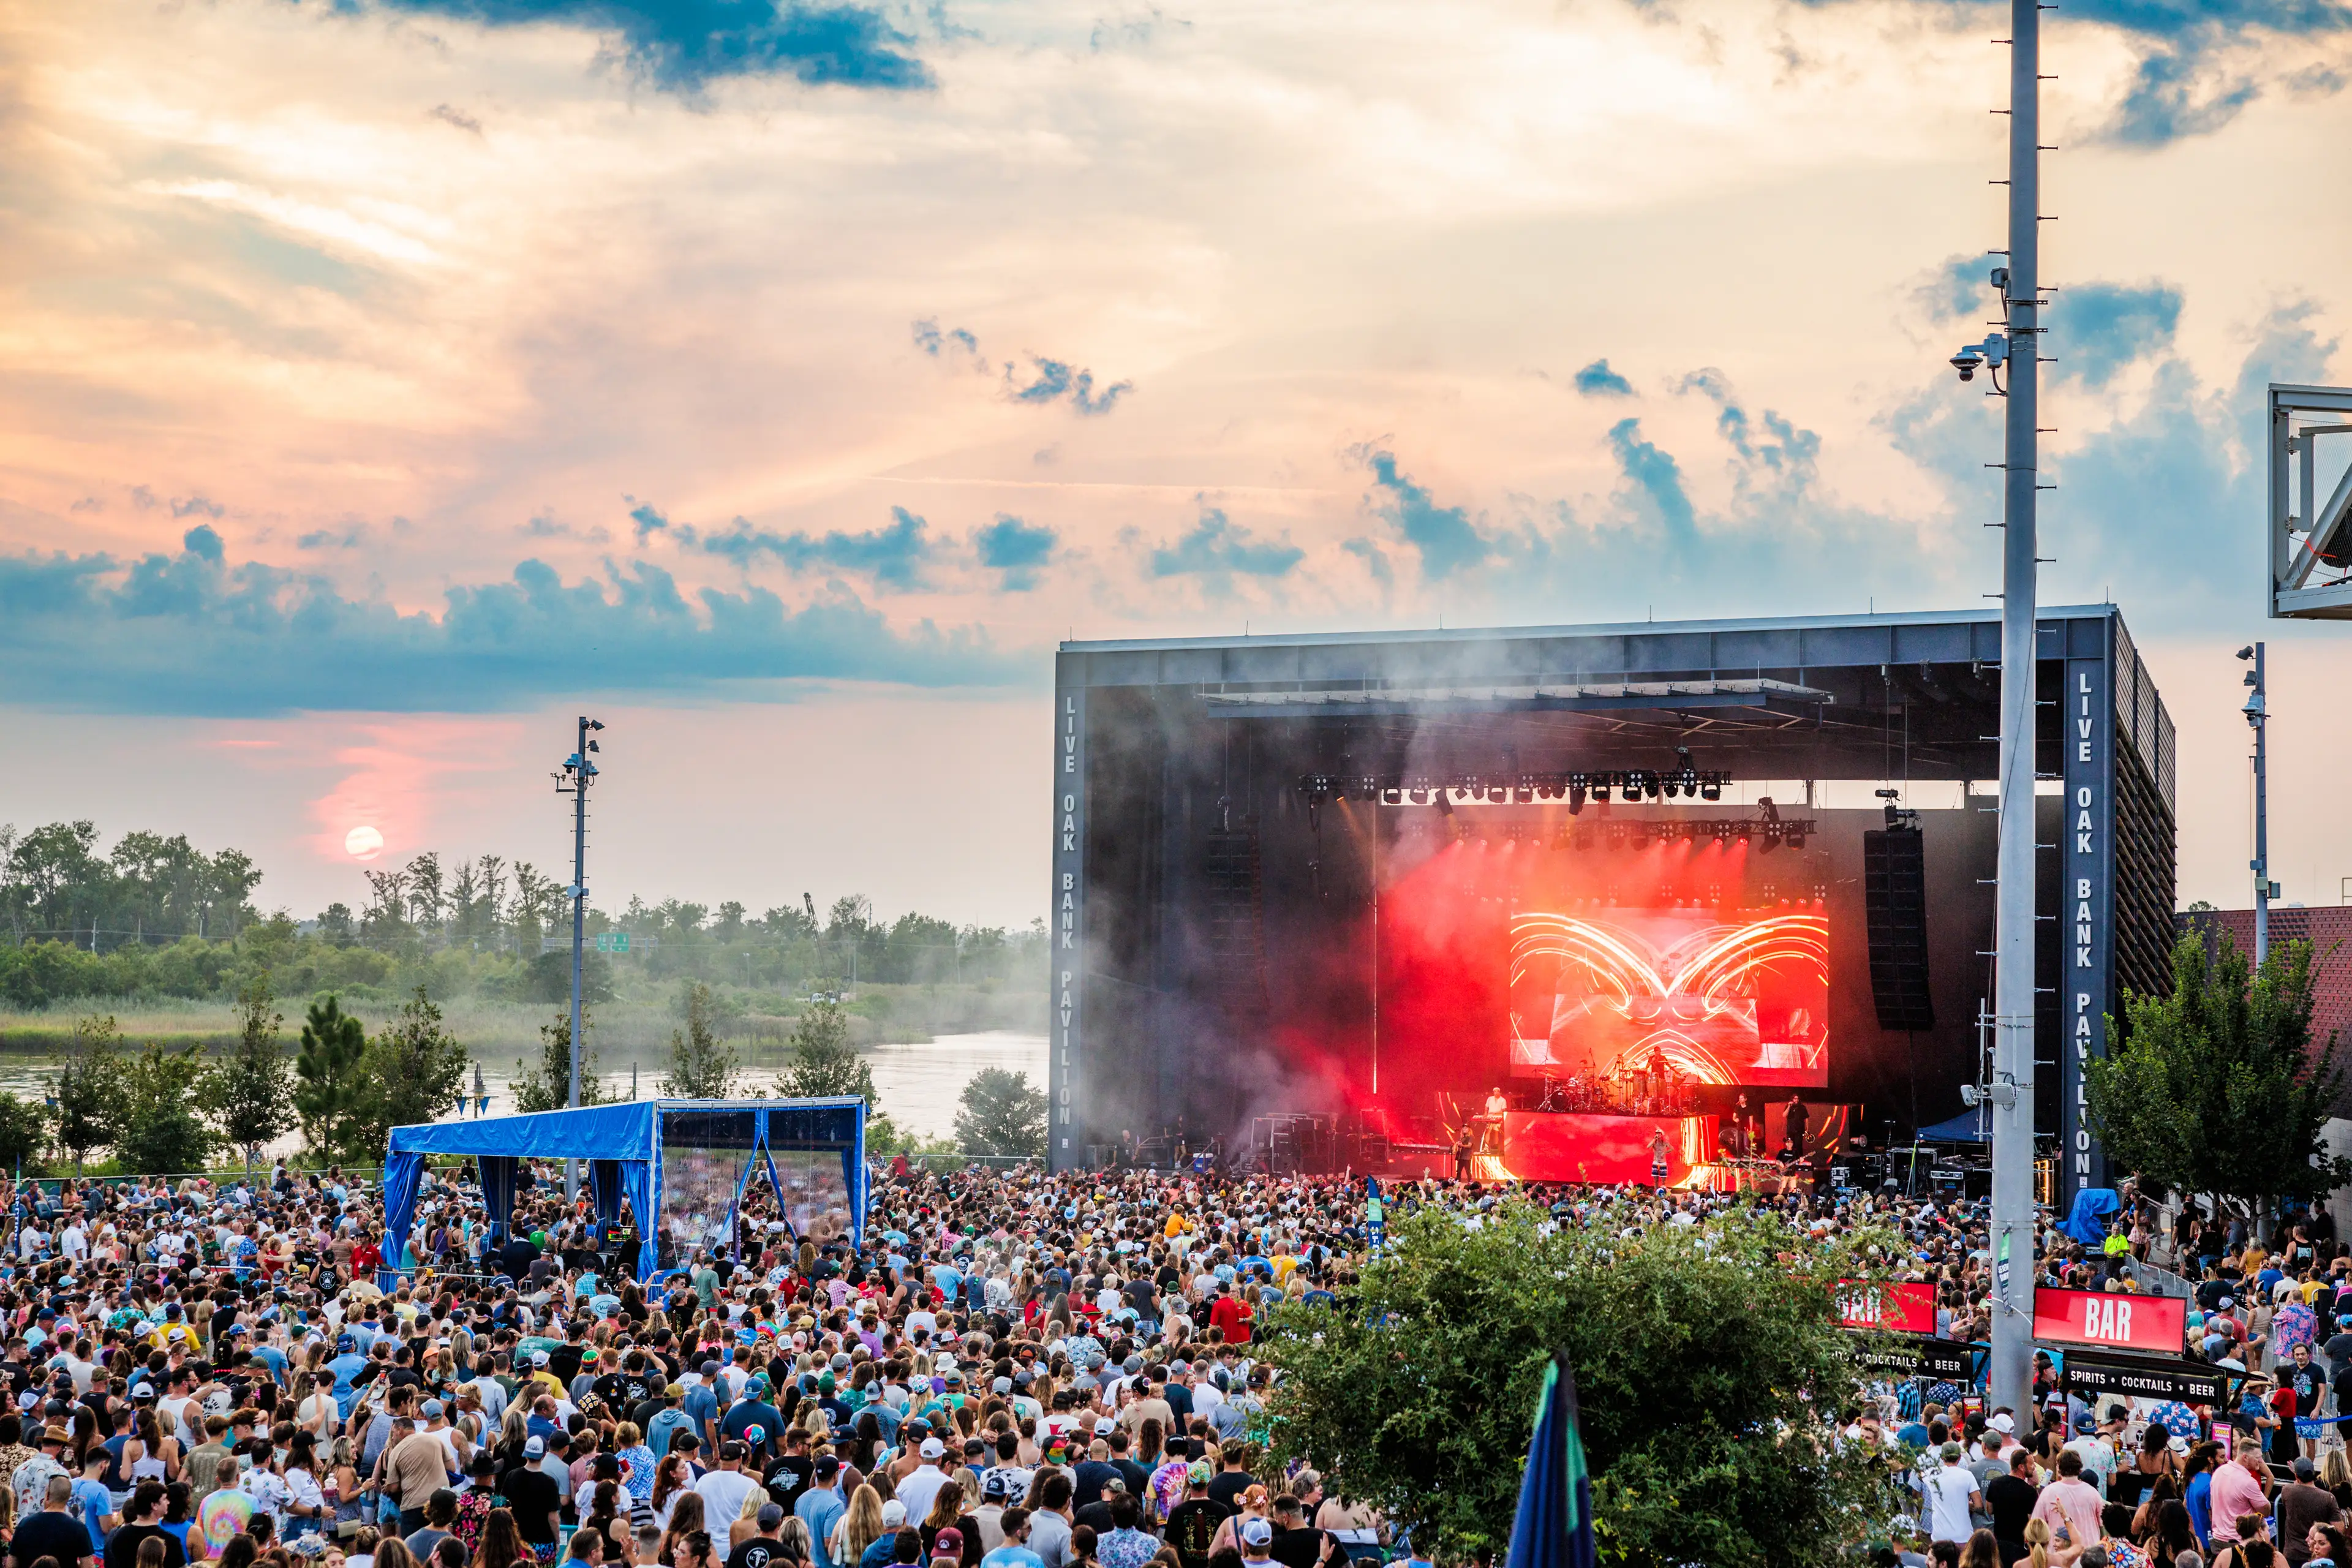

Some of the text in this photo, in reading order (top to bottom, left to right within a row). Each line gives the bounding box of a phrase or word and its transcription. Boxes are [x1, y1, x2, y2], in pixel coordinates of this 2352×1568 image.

[2078, 673, 2092, 762] LIVE
[2076, 787, 2092, 854] OAK
[1059, 696, 1076, 1125] LIVE OAK BANK PAVILION
[2076, 878, 2092, 968] BANK
[2084, 1298, 2132, 1342] BAR
[1866, 1353, 1917, 1368] COCKTAILS
[1935, 1359, 1961, 1372] BEER
[2070, 1370, 2215, 1396] SPIRITS COCKTAILS BEER
[1163, 1474, 1186, 1492] BISCU
